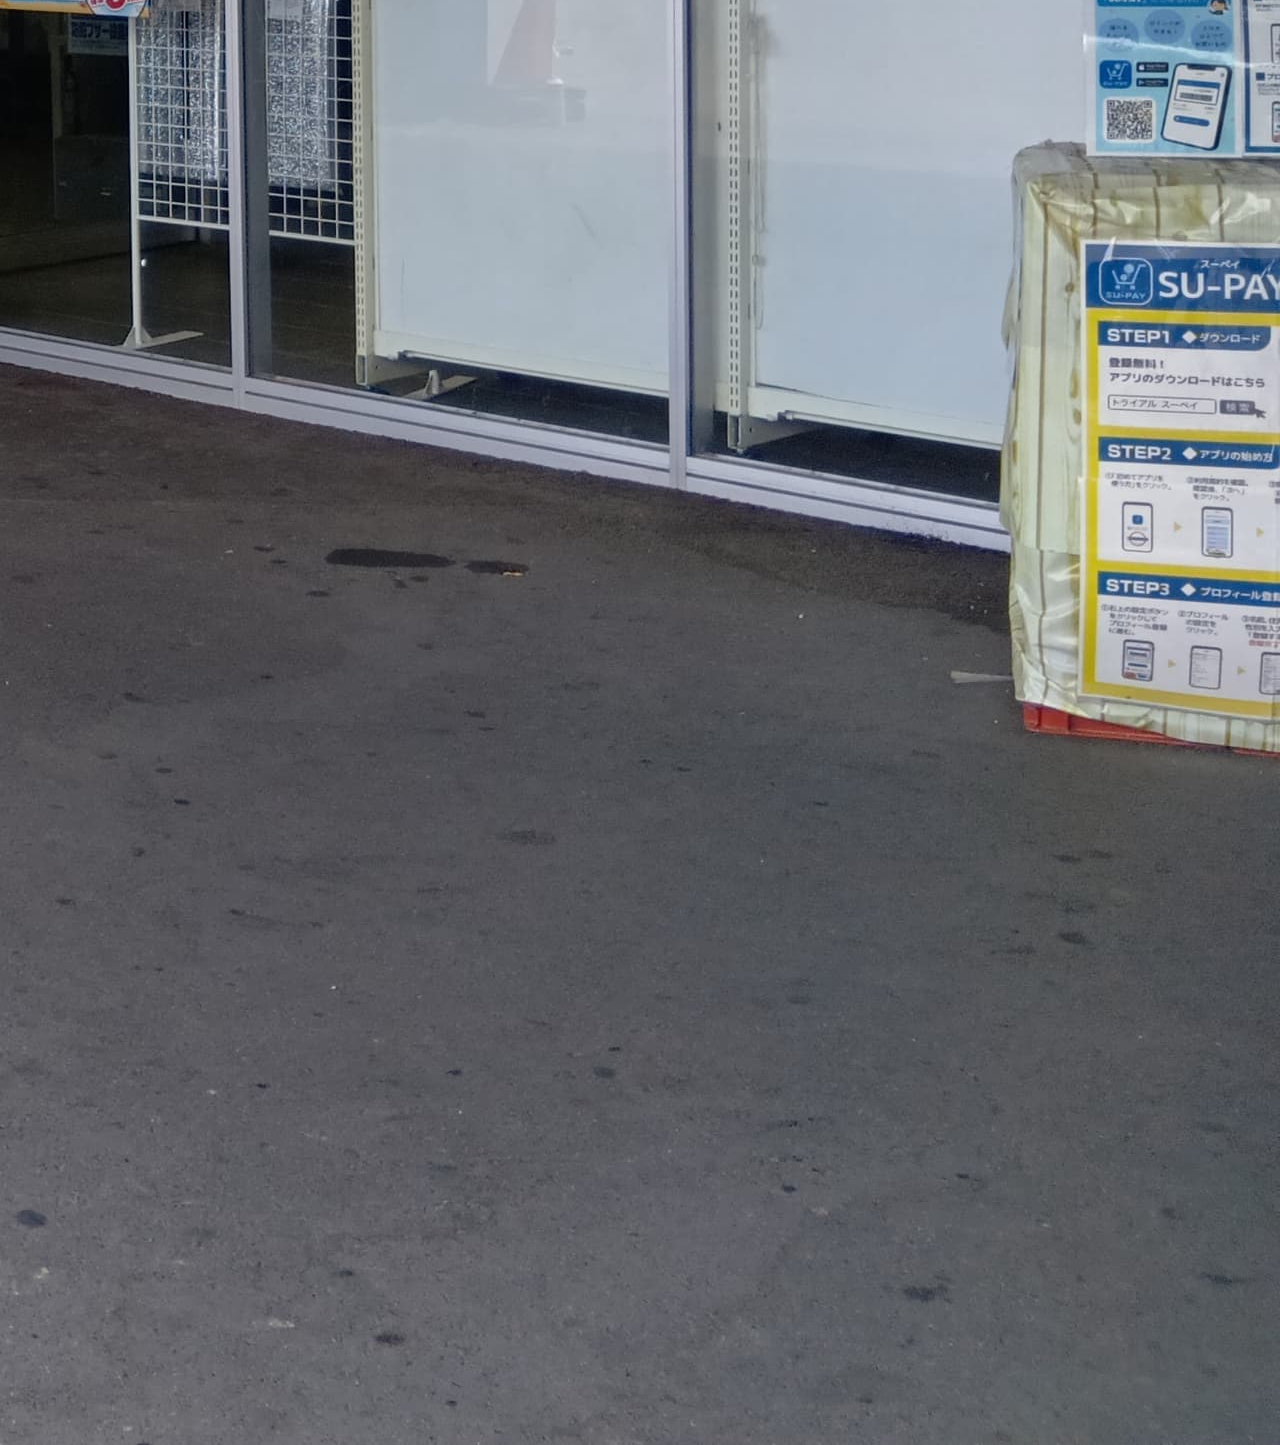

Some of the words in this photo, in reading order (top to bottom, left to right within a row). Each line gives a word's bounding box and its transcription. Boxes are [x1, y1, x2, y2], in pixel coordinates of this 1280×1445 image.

[1107, 328, 1170, 344] STEP1
[1200, 332, 1262, 345] ダウンロード
[1109, 357, 1165, 370] 登録無料!
[1109, 372, 1266, 389] アプリのダウンロードはこちら
[1113, 398, 1157, 409] トライアル
[1161, 401, 1199, 410] スーペイ
[1107, 444, 1172, 461] STEP2
[1199, 449, 1273, 463] アプリの始め方
[1106, 579, 1170, 596] STEP3
